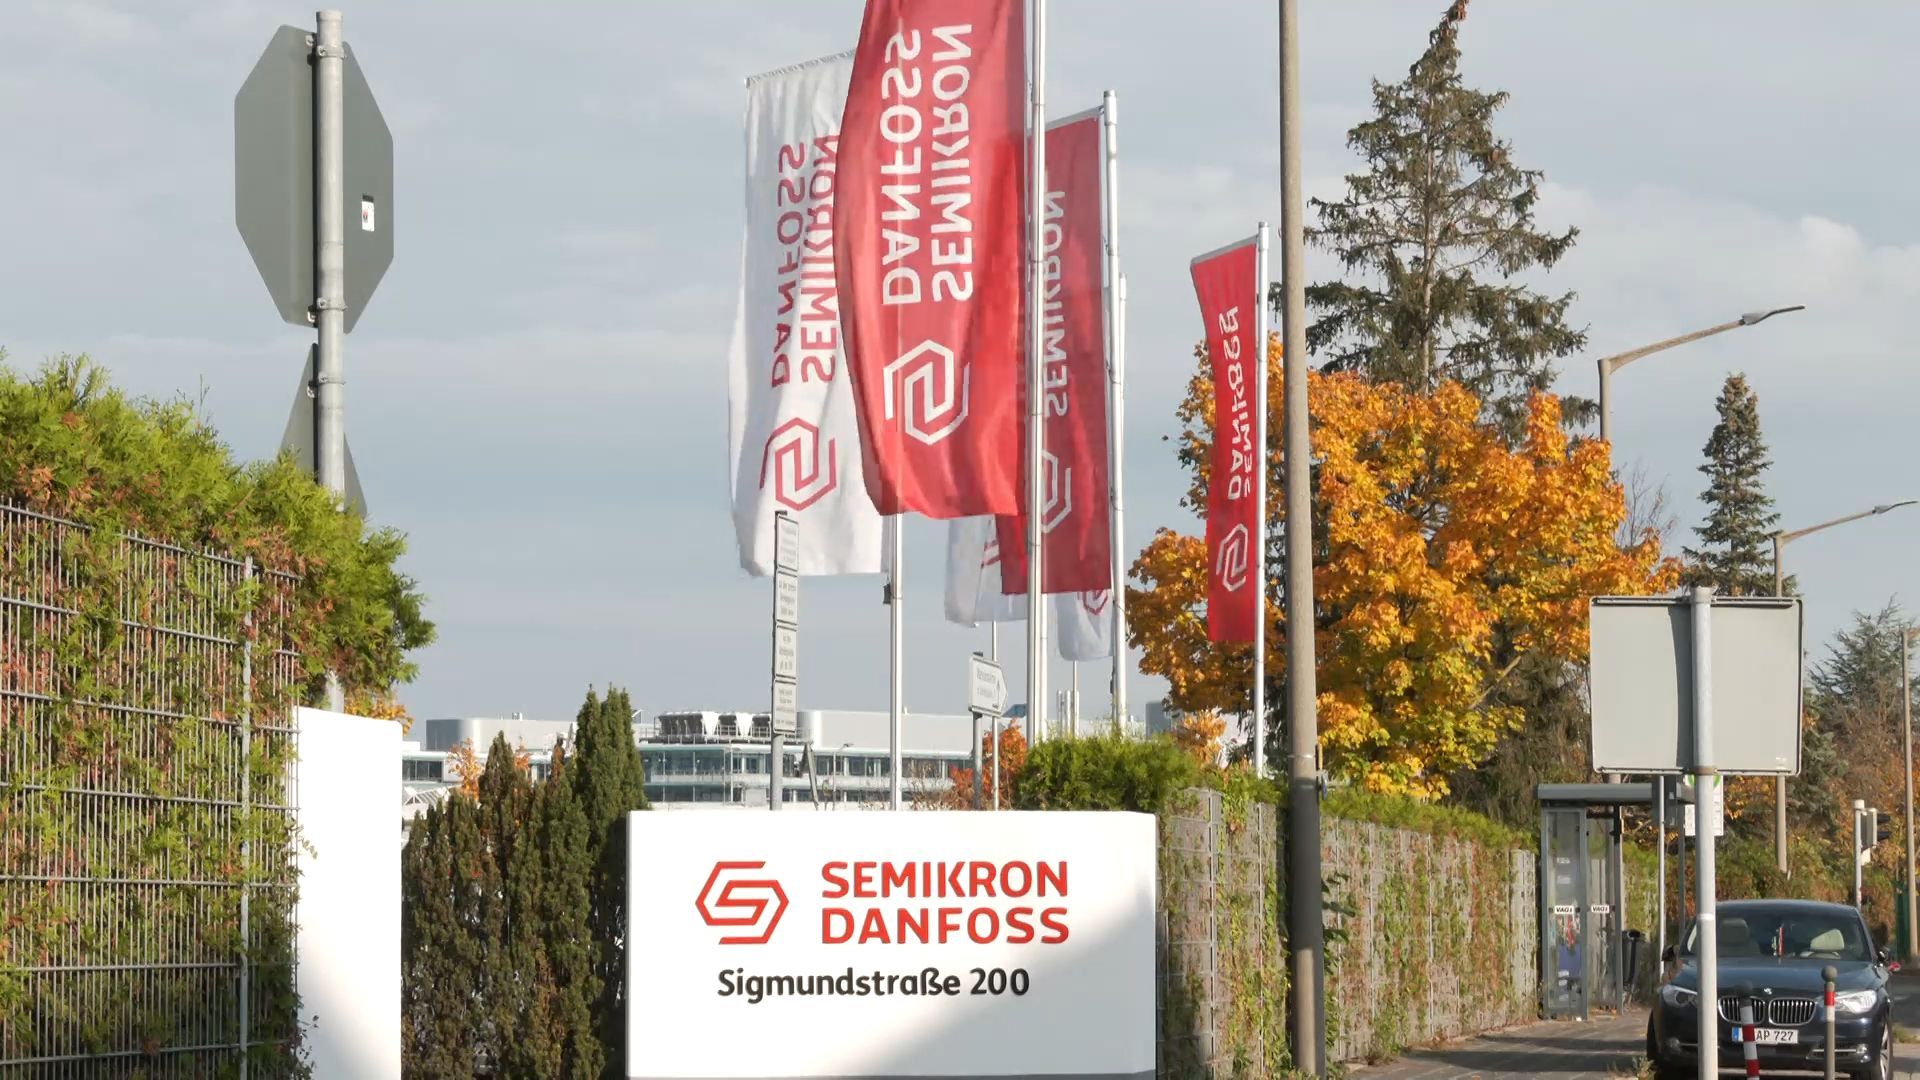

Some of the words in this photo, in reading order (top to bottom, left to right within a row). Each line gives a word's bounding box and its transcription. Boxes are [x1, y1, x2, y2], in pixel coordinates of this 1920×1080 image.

[822, 860, 1069, 899] SEMIKRON
[822, 906, 1070, 945] DANFOSS
[718, 967, 961, 1004] Sigmundstraße
[970, 967, 1030, 997] 200
[1756, 1030, 1770, 1041] AP
[1774, 1030, 1794, 1041] 727
